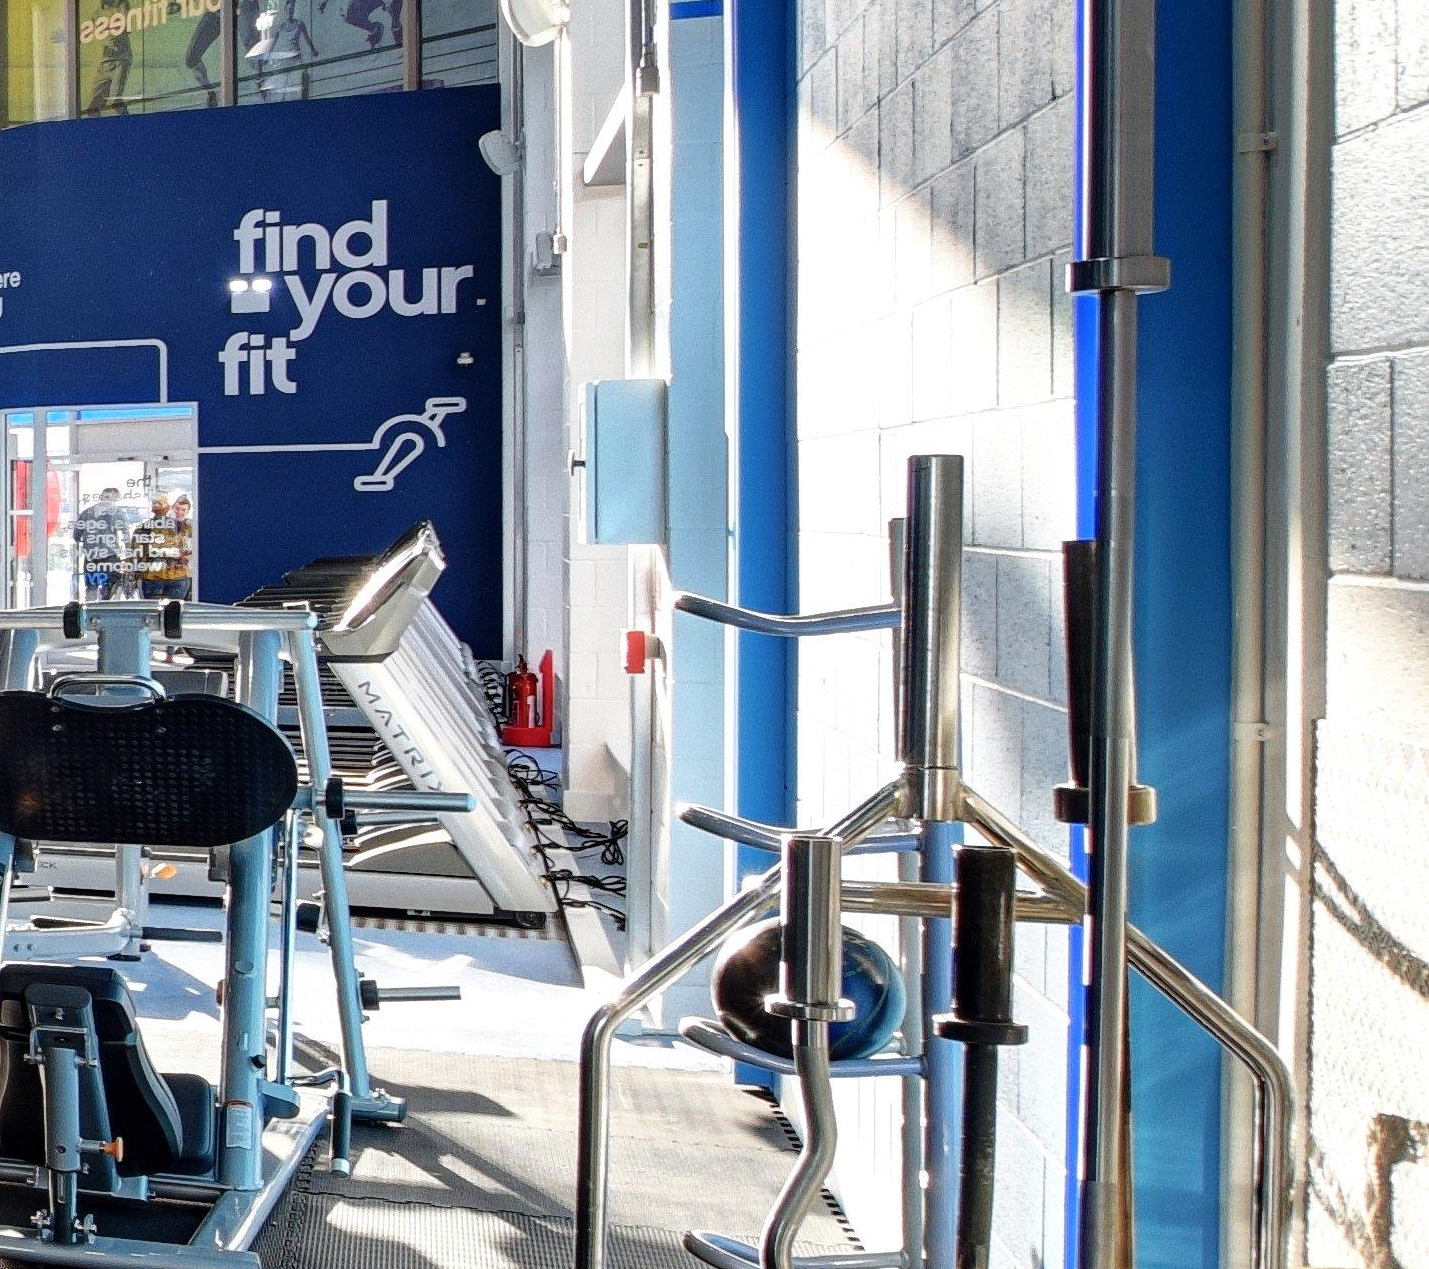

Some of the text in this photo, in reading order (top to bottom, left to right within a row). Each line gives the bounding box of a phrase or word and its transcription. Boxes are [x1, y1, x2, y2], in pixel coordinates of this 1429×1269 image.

[233, 199, 388, 274] find
[283, 264, 474, 342] your
[218, 331, 298, 396] fit
